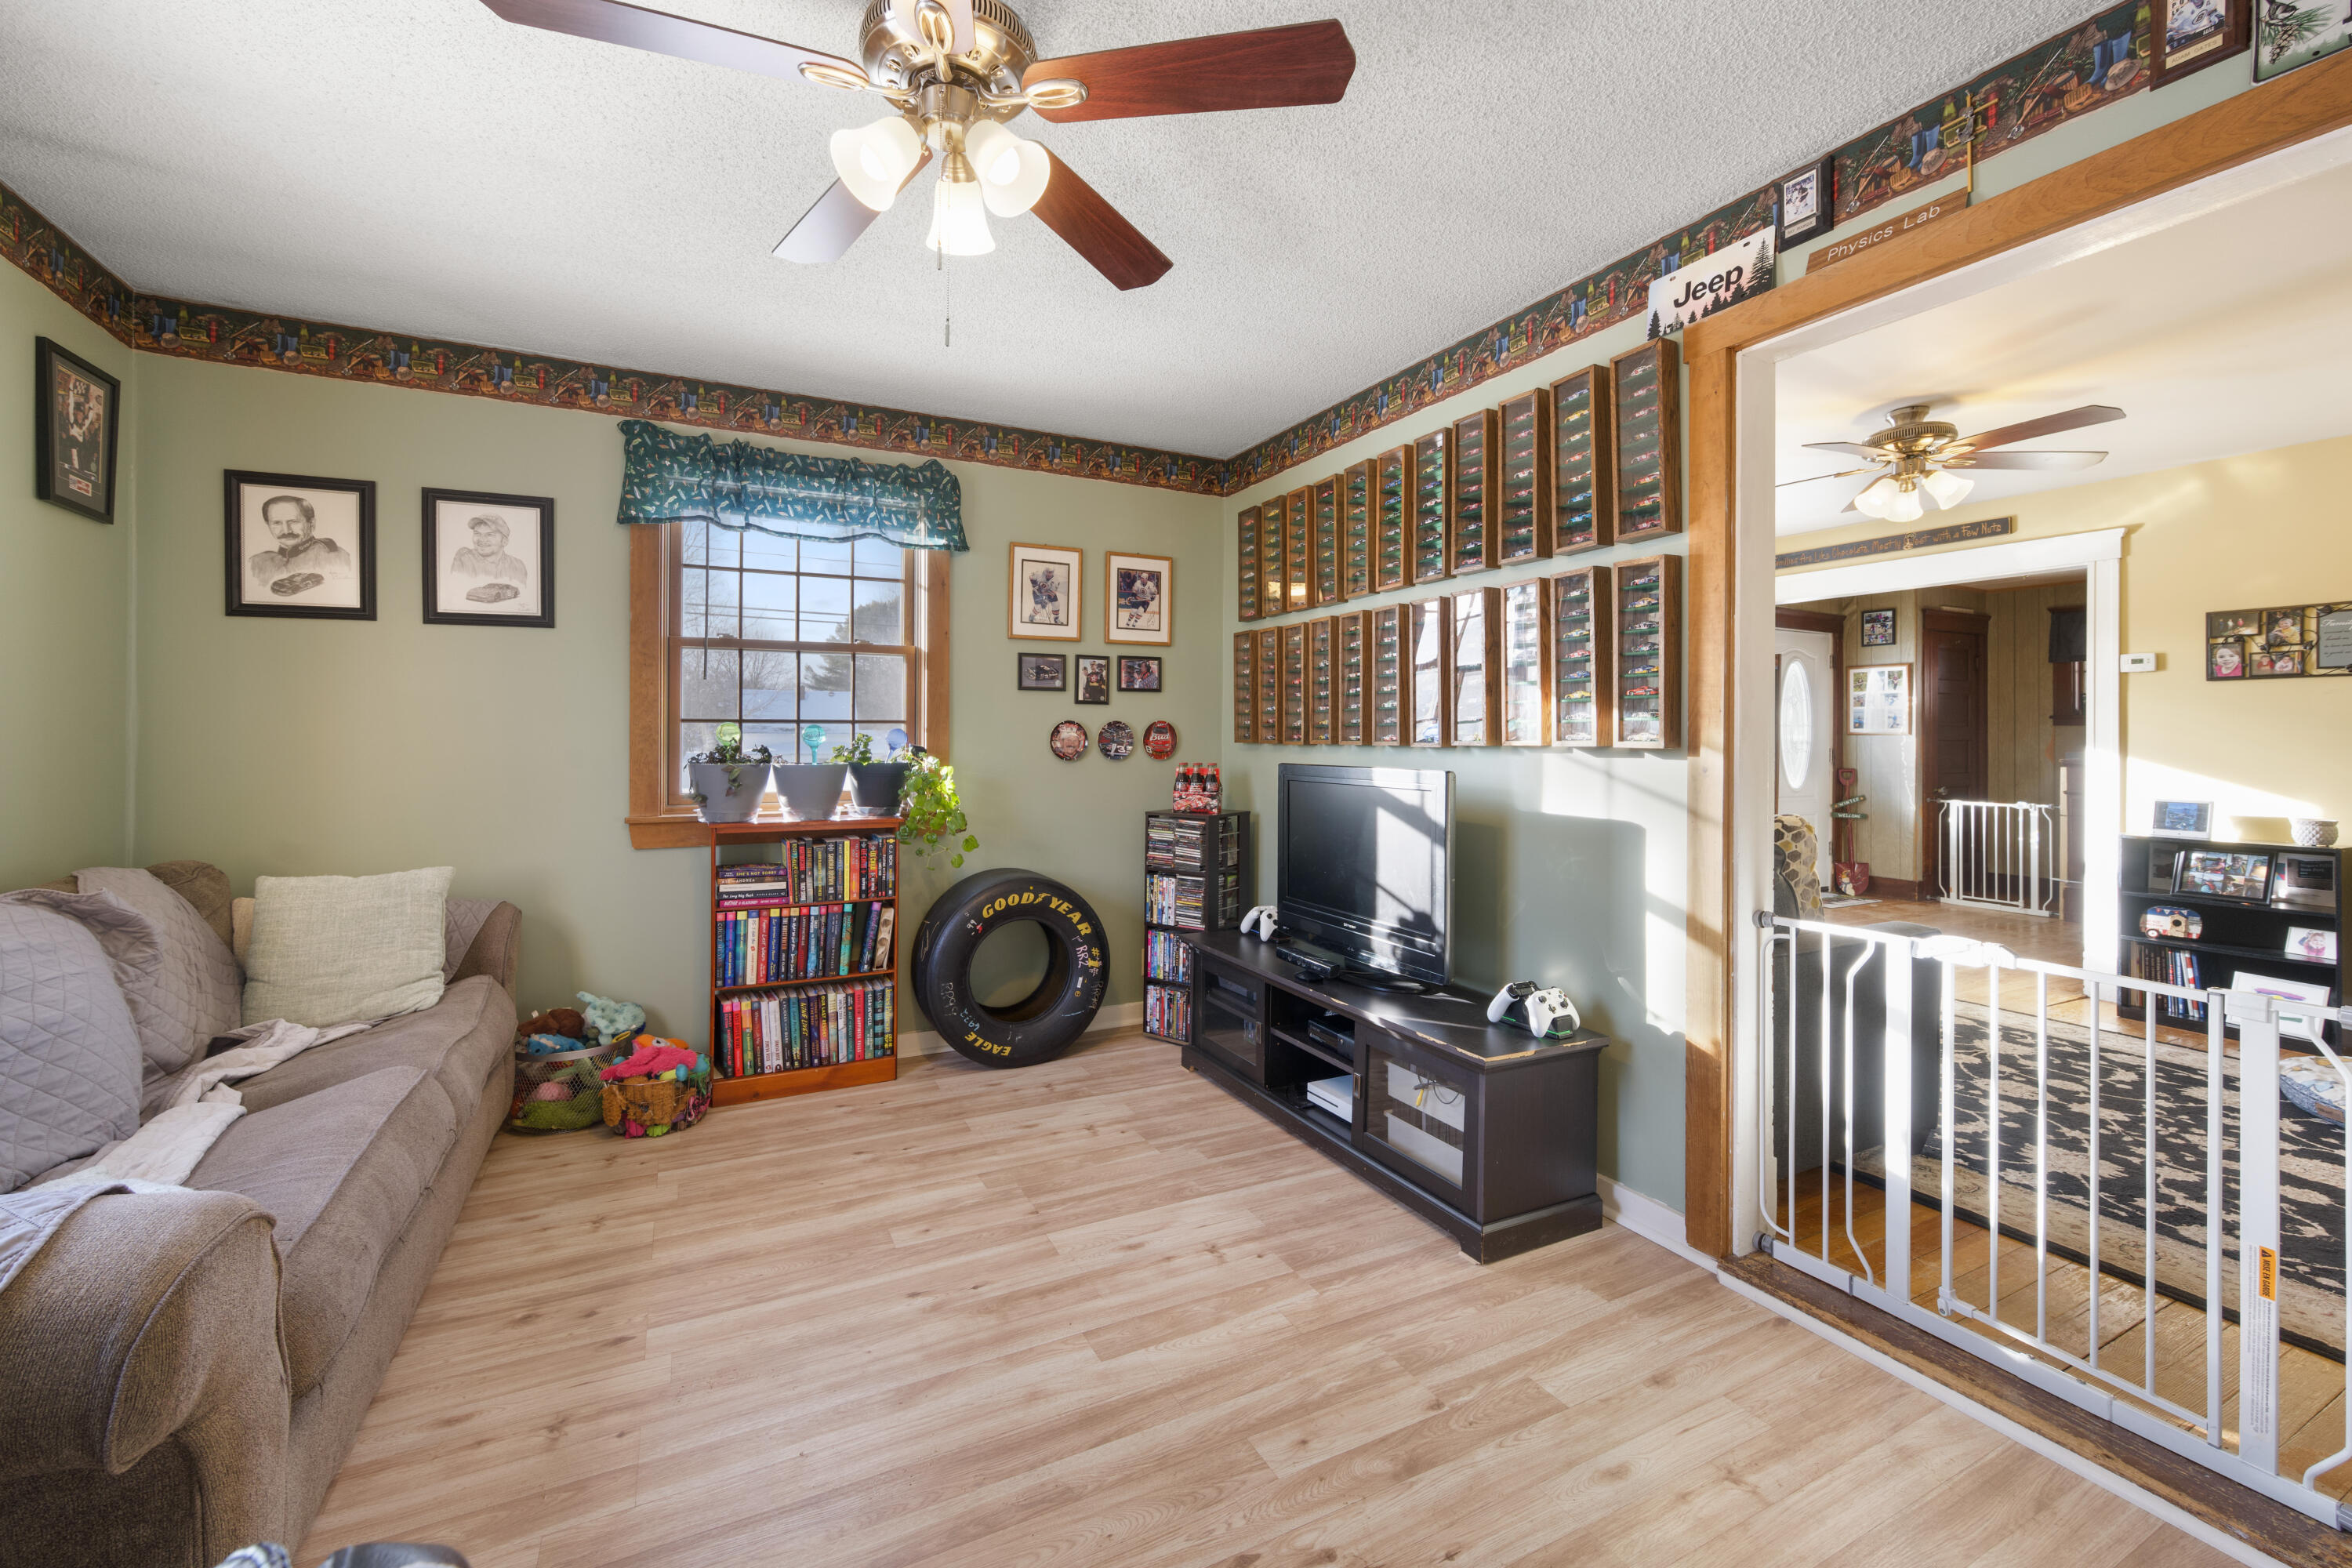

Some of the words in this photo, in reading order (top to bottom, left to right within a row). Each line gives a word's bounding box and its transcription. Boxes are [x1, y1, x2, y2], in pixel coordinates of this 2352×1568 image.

[1827, 225, 1893, 262] Physics
[1903, 204, 1940, 230] Lab
[1673, 265, 1744, 308] Jeep
[1814, 551, 1831, 562] Like
[1871, 538, 1902, 553] Mostly
[1962, 525, 1980, 537] Few
[1981, 522, 2002, 535] Nuts
[964, 1031, 1012, 1057] EAGLE
[2263, 1272, 2270, 1280] EN
